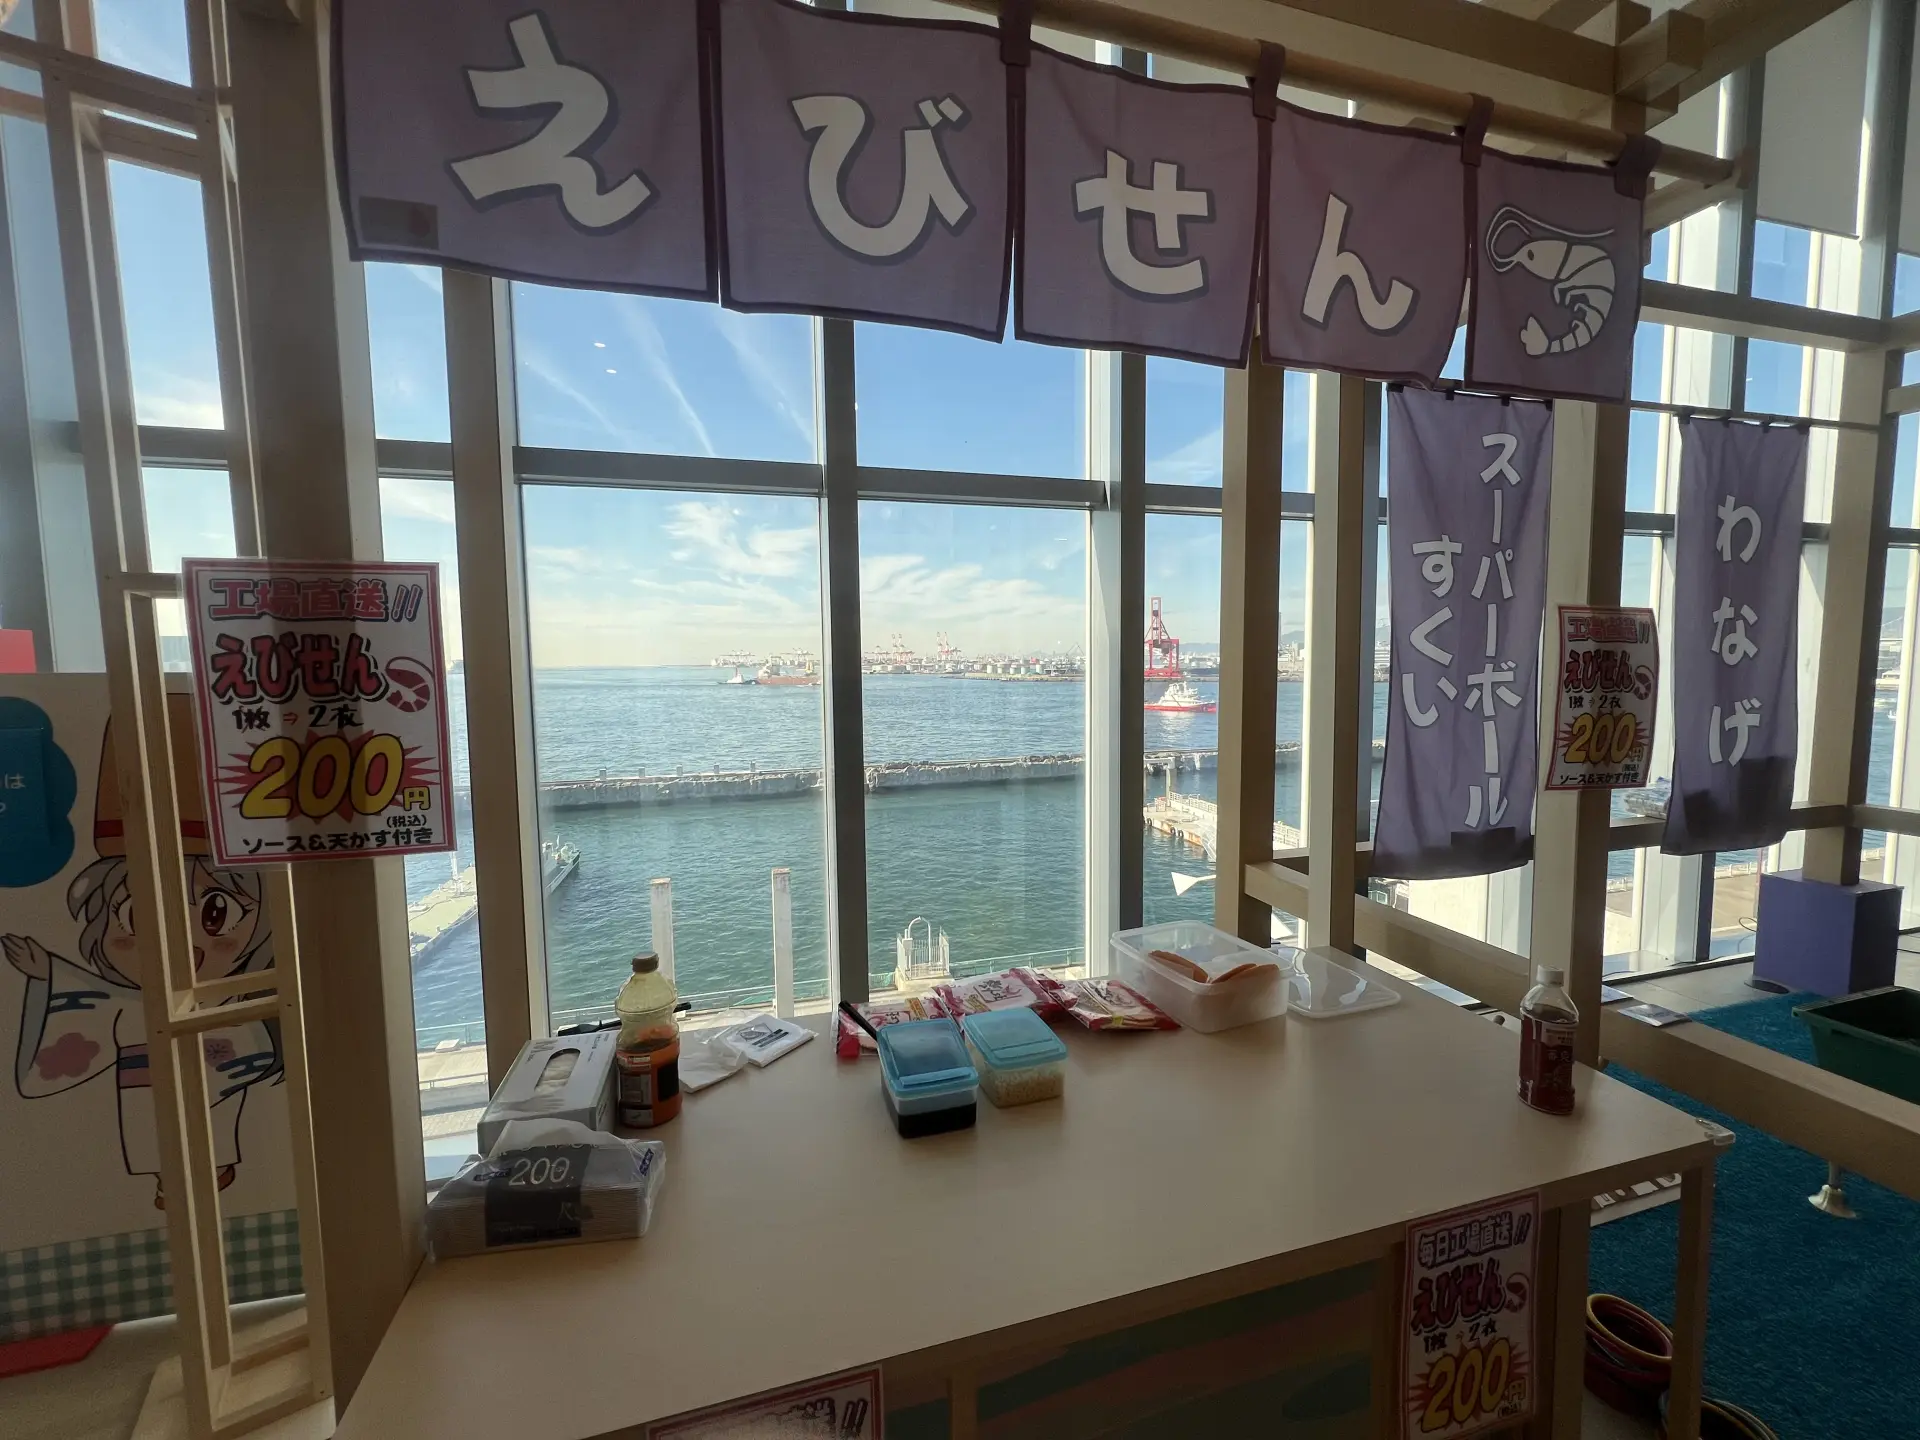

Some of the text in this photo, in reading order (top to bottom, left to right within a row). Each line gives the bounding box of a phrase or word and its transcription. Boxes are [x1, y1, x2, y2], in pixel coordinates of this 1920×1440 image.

[449, 11, 1414, 331] えびせん
[210, 632, 391, 705] えびせん
[1402, 534, 1463, 728] すくい
[1464, 431, 1523, 828] スーパーボール
[1564, 649, 1635, 694] えびせん
[1708, 494, 1763, 767] わなげ
[508, 1156, 570, 1187] 200
[1411, 1257, 1506, 1336] えびせん
